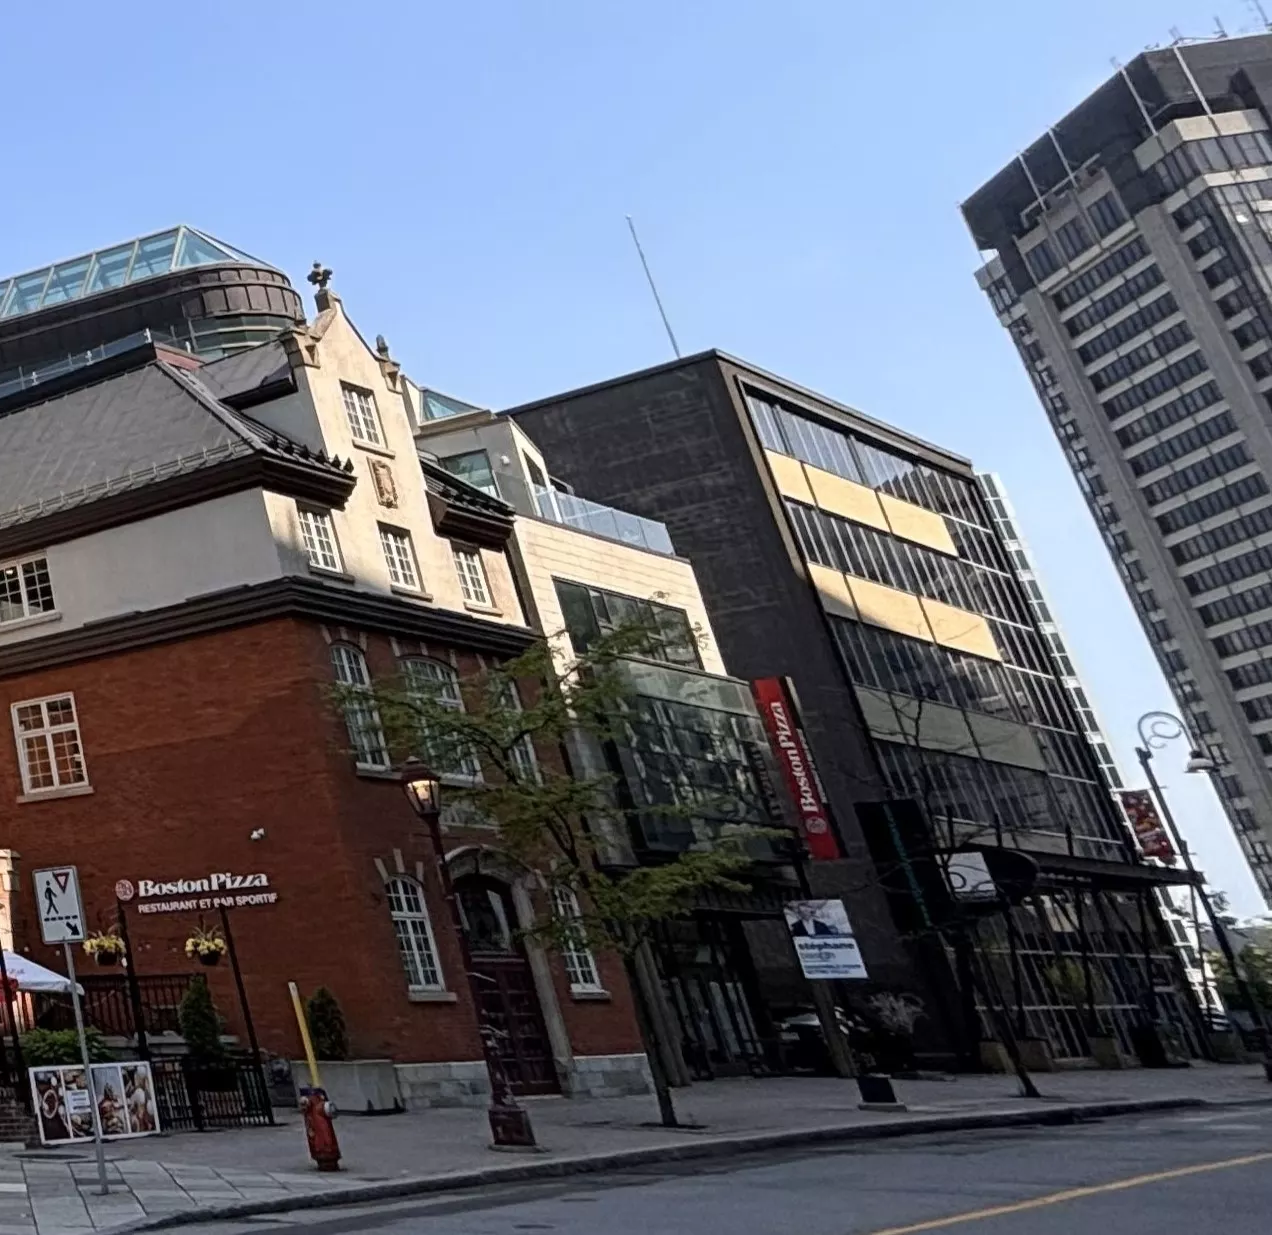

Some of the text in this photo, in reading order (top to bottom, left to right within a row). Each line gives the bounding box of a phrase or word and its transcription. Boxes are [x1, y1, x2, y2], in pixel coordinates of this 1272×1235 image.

[770, 701, 794, 749] Pizza
[787, 749, 819, 813] Boston
[137, 877, 209, 898] Boston
[210, 872, 269, 891] Pizza
[137, 899, 197, 914] RESTAURANT
[199, 898, 211, 909] ET
[235, 892, 278, 907] SPORTIF
